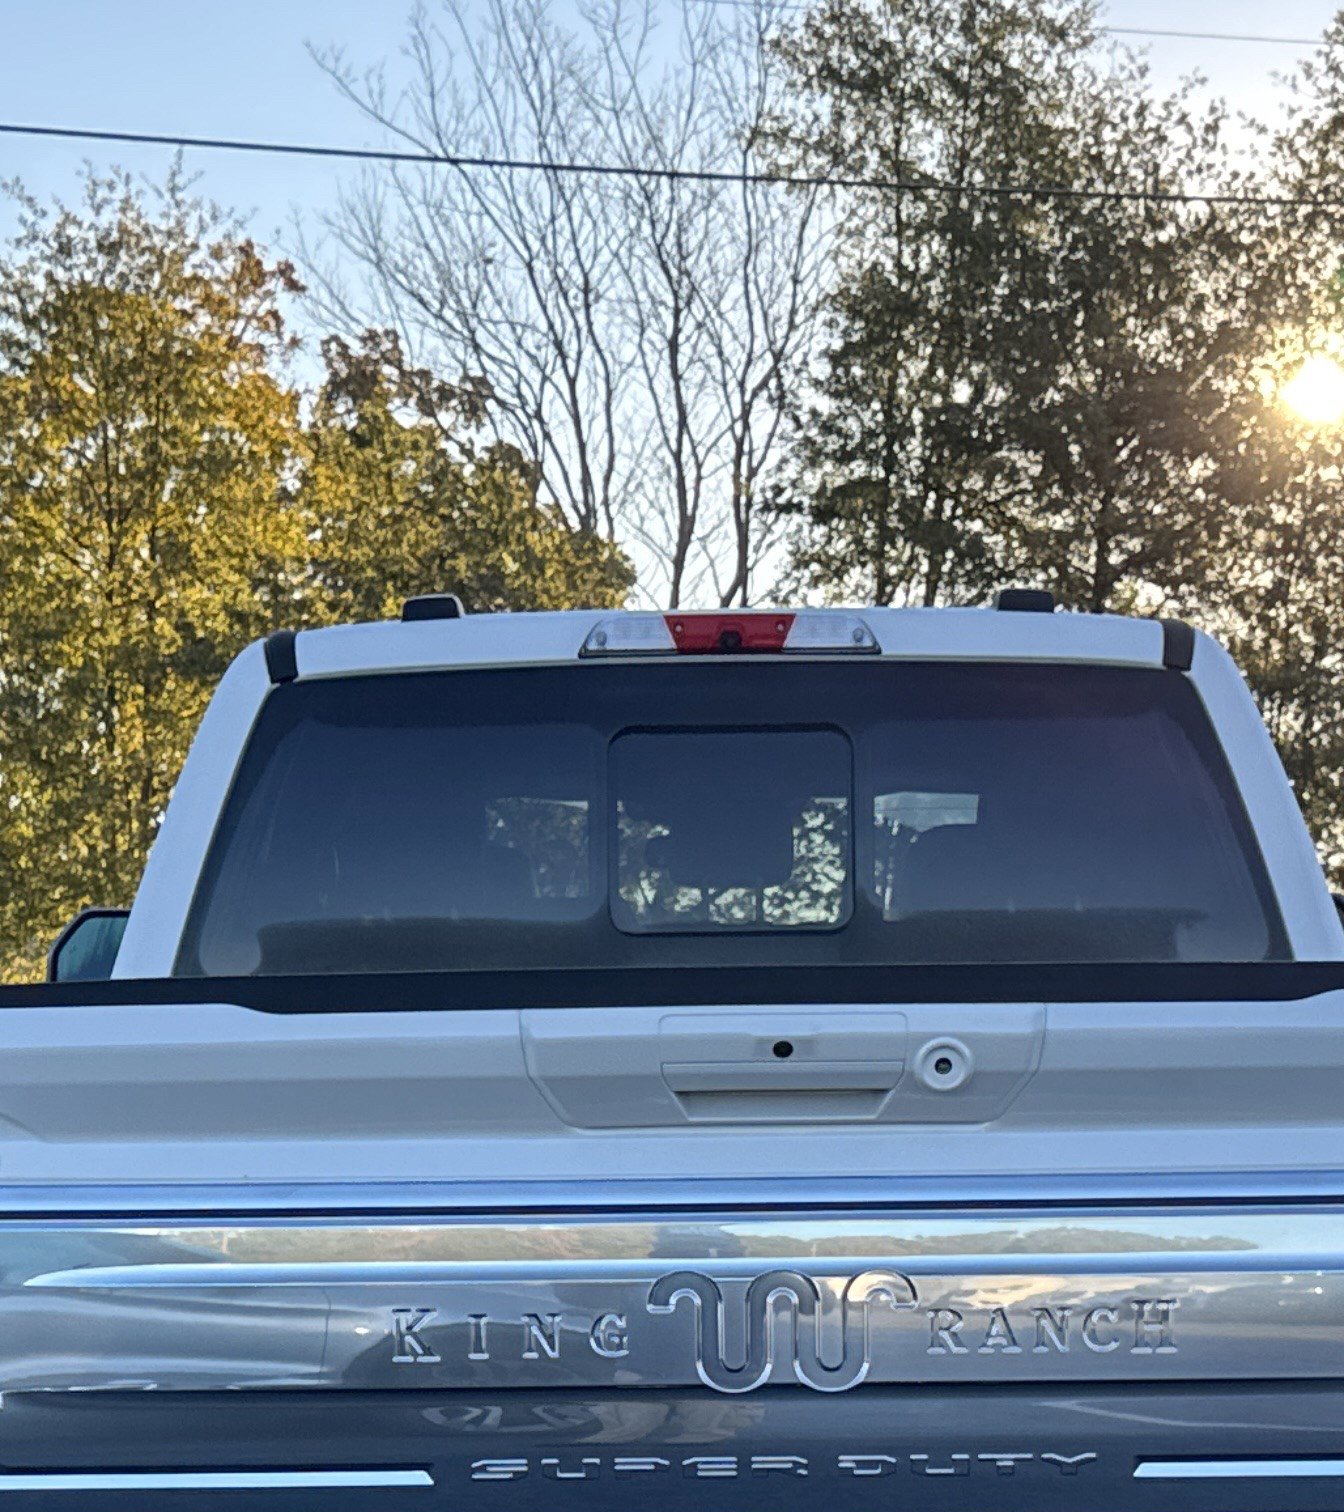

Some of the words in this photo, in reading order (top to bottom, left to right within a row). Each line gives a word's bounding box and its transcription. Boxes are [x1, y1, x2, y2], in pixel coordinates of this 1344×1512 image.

[390, 1307, 632, 1364] KING
[925, 1298, 1182, 1356] RANCH
[471, 1455, 810, 1482] SUPER
[837, 1451, 1098, 1477] DUTY
